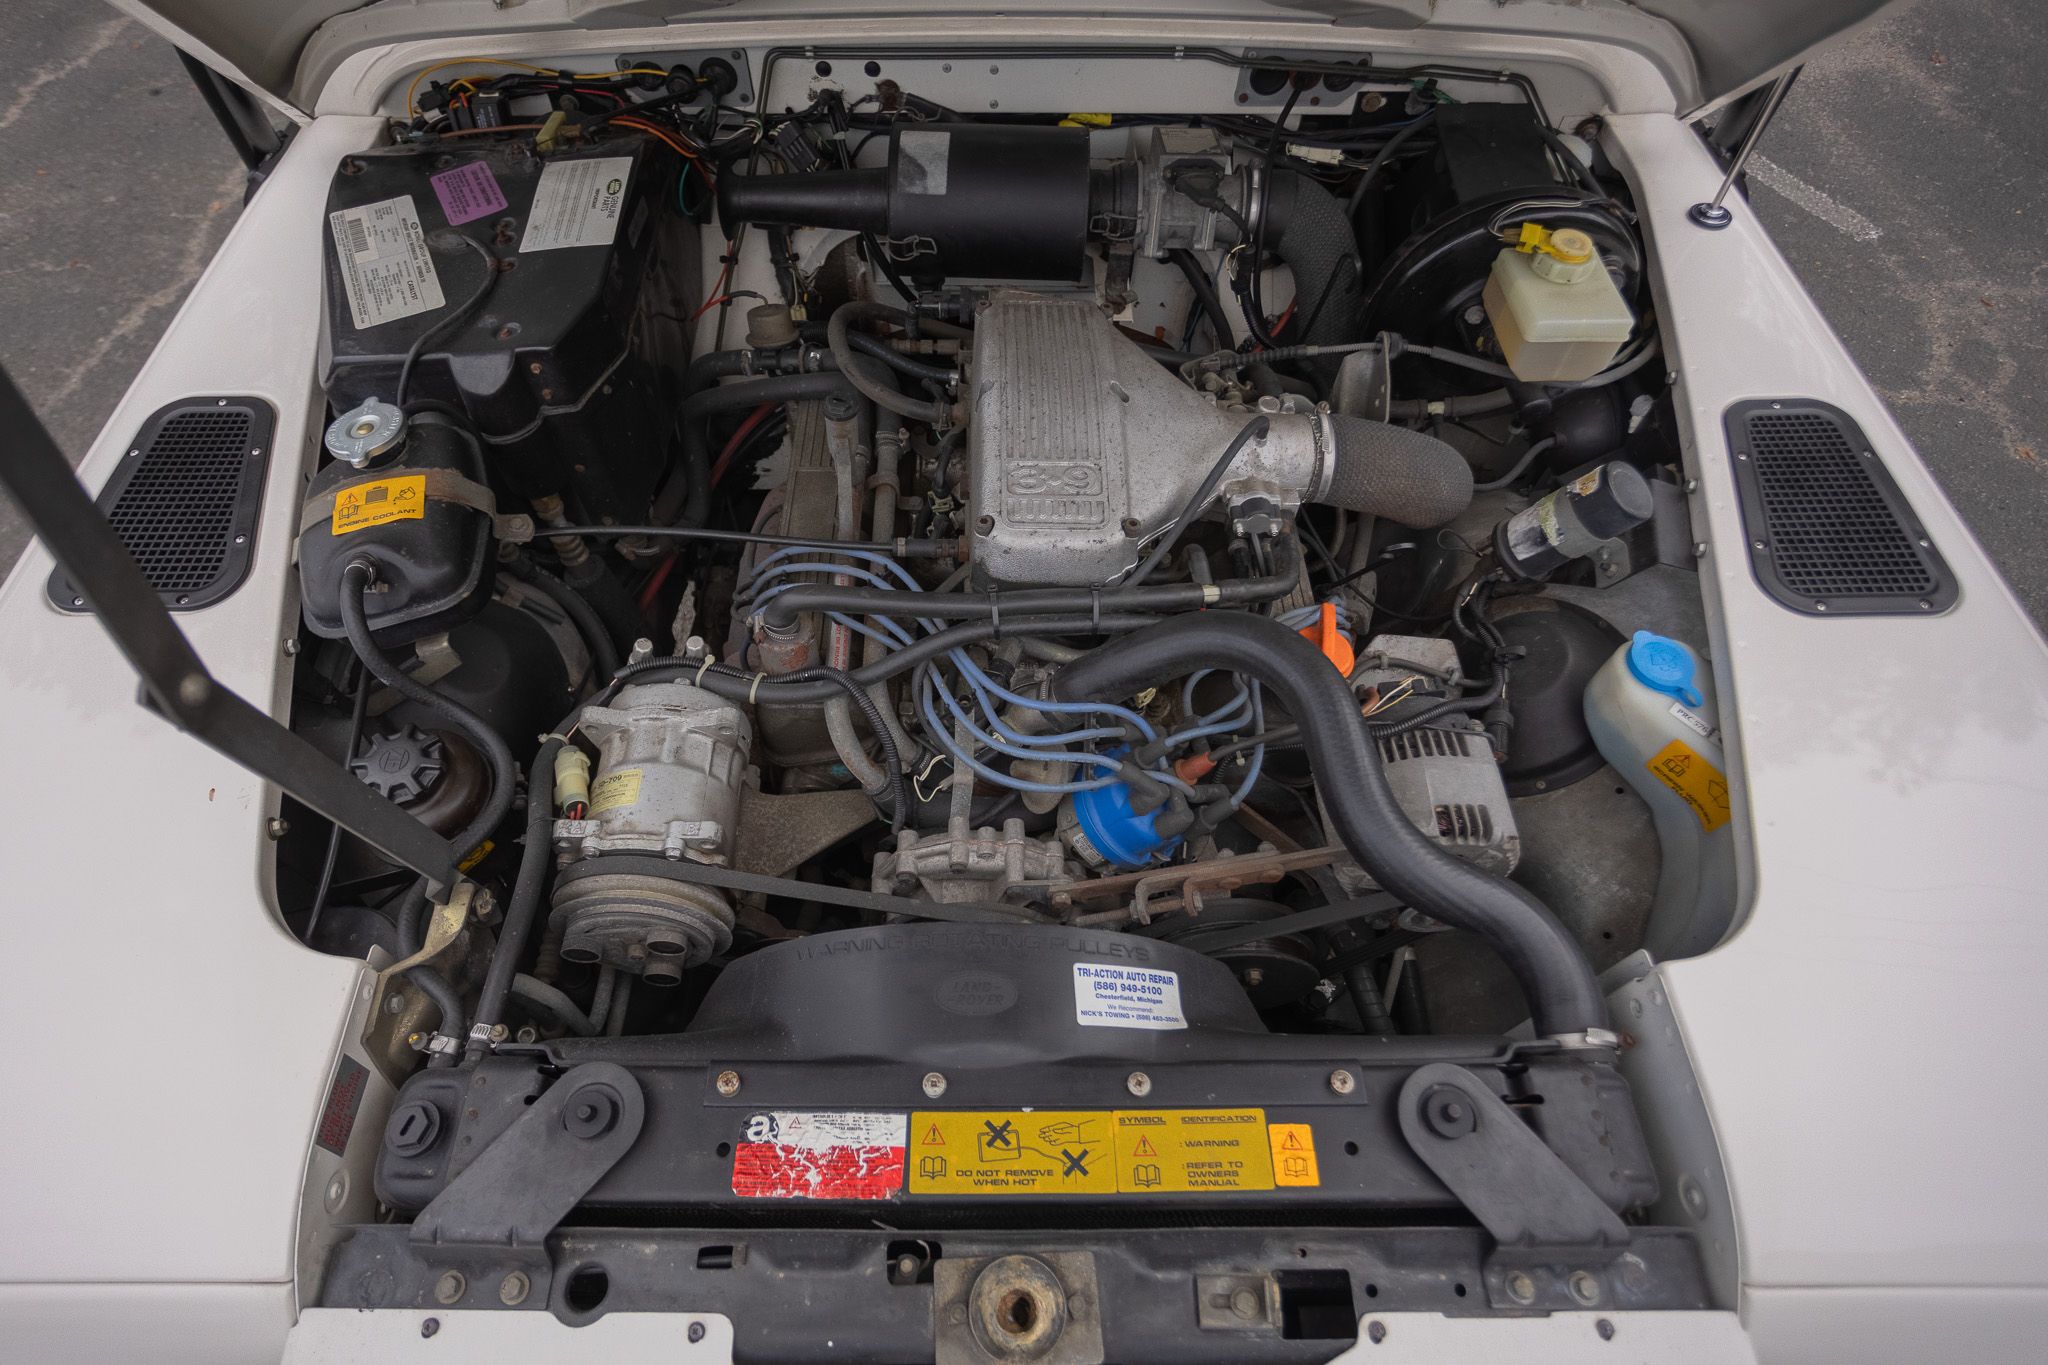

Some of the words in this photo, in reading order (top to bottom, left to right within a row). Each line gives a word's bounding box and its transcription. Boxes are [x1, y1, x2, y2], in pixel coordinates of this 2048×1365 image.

[601, 196, 610, 211] PARTS
[607, 196, 619, 218] GENUINE
[338, 517, 370, 529] ENGINE
[372, 508, 417, 521] COOLANT
[914, 932, 1042, 949] ROTATING
[1051, 935, 1151, 961] PULLEYS
[1077, 967, 1124, 980] TRI-ACTION
[1126, 972, 1146, 983] AUTO
[1149, 974, 1174, 986] REPAIR
[1093, 981, 1118, 993] (586)
[1121, 983, 1163, 995] 949-5100
[1095, 993, 1136, 1002] Chesterfield,
[1137, 996, 1163, 1004] Michigan
[1119, 1116, 1166, 1124] SYMBOL
[1181, 1115, 1257, 1124] IDENTIFICATION
[956, 1169, 973, 1177] DO
[976, 1169, 1000, 1177] NOT
[1005, 1169, 1054, 1177] REMOVE
[1187, 1170, 1239, 1178] OWNERS
[973, 1178, 1009, 1186] WHEN
[1012, 1178, 1037, 1186] HOT
